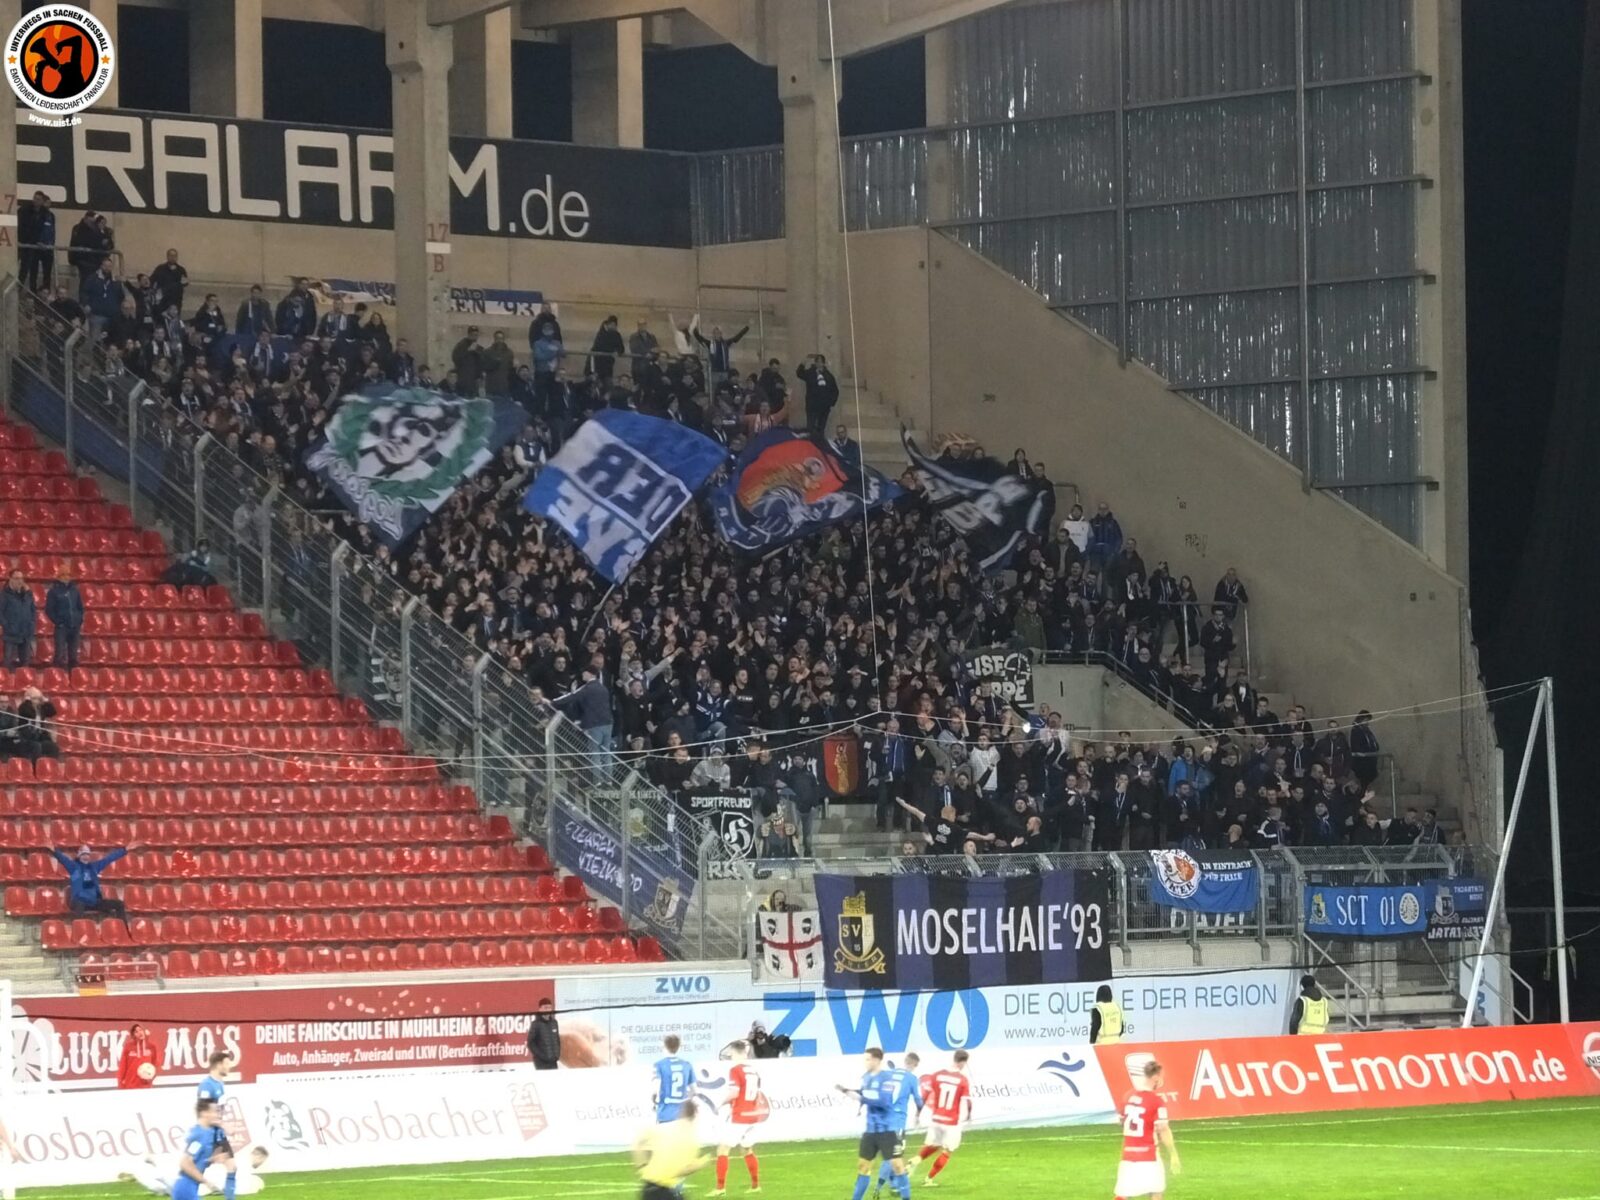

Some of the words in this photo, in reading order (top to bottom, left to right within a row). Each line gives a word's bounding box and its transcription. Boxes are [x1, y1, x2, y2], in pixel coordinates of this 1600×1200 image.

[428, 224, 448, 242] 17
[433, 254, 445, 273] B
[1336, 895, 1368, 926] SCT
[1380, 896, 1395, 926] 01
[656, 976, 710, 993] ZWO
[1004, 993, 1040, 1016] DIE
[1048, 989, 1135, 1015] QUEE
[1142, 987, 1187, 1010] DER
[1195, 983, 1277, 1008] REGION
[256, 1023, 295, 1044] DEINE
[298, 1019, 383, 1042] FAHRSCHULE
[384, 1020, 399, 1040] IN
[475, 1017, 486, 1035] &
[487, 1014, 536, 1034] RODGA
[621, 1026, 632, 1034] DIE
[634, 1024, 664, 1033] QUELLE
[665, 1023, 682, 1032] DER
[683, 1022, 712, 1031] REGION
[763, 986, 990, 1057] ZWO
[273, 1051, 299, 1067] Auto,
[301, 1048, 351, 1066] Anhänger,
[354, 1047, 393, 1062] Zweirad
[395, 1046, 413, 1061] und
[416, 1045, 437, 1060] LKW
[670, 1070, 684, 1098] 2
[938, 1083, 958, 1110] 11
[308, 1097, 505, 1146] Rosbacher
